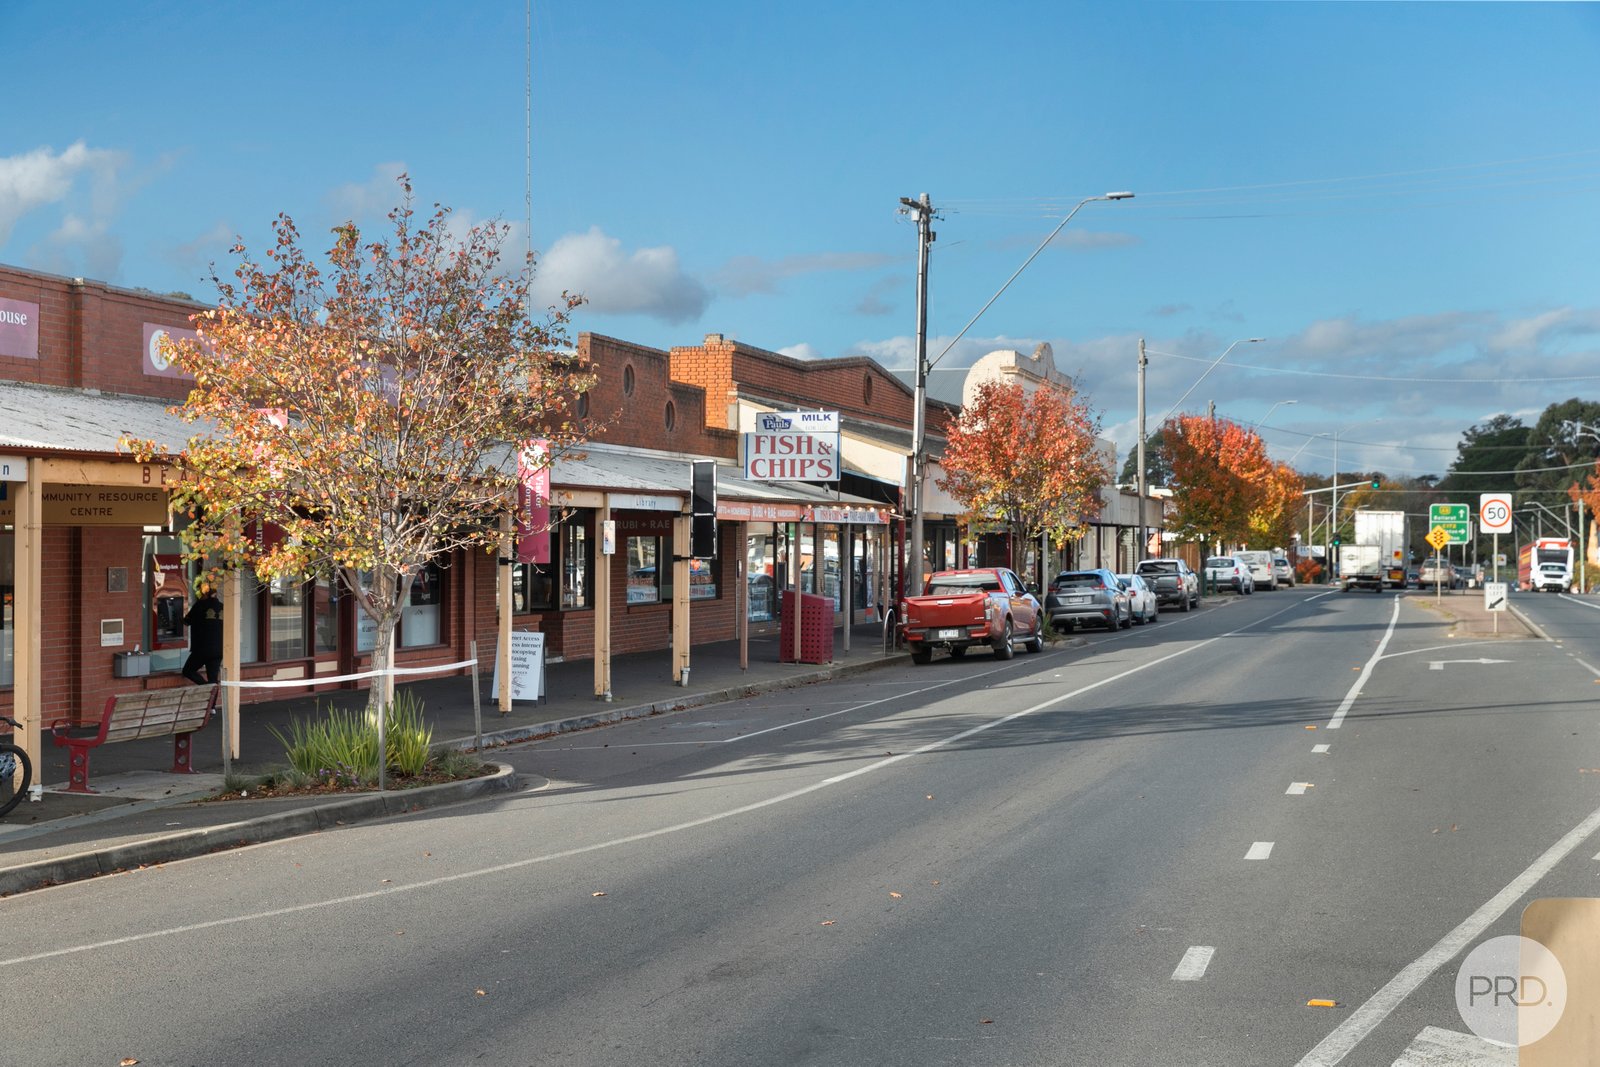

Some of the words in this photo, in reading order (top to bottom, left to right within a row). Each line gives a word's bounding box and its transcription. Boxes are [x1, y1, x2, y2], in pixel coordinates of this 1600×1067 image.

[801, 413, 832, 422] MILK
[767, 420, 790, 429] Pauls
[754, 435, 813, 455] FISH
[817, 441, 833, 455] &
[750, 458, 833, 478] CHIPS
[535, 475, 544, 508] Visitor
[98, 492, 159, 502] RESOURCE
[636, 498, 656, 509] Library
[70, 507, 113, 516] CENTRE
[1488, 507, 1506, 520] 50
[617, 520, 638, 529] RUBI
[650, 520, 671, 529] RAE
